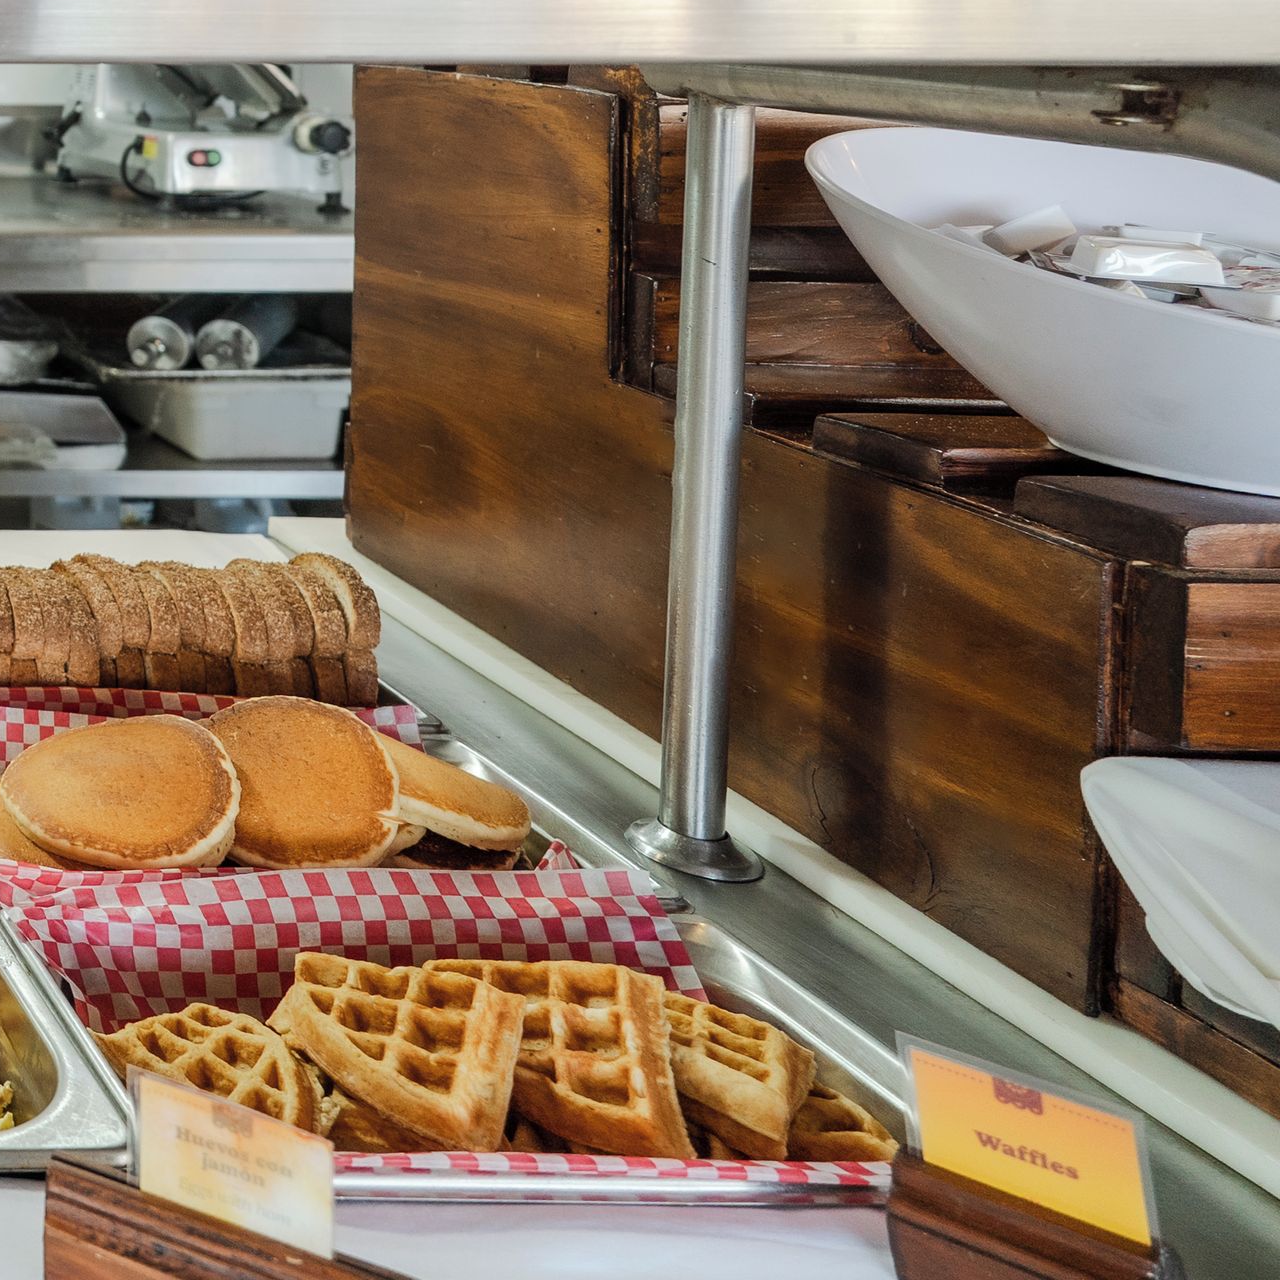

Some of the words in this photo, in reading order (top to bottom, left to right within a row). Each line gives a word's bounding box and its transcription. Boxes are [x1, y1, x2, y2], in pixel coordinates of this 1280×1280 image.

[175, 1124, 250, 1163] Huevos
[255, 1155, 293, 1179] con
[974, 1129, 1080, 1180] Waffles
